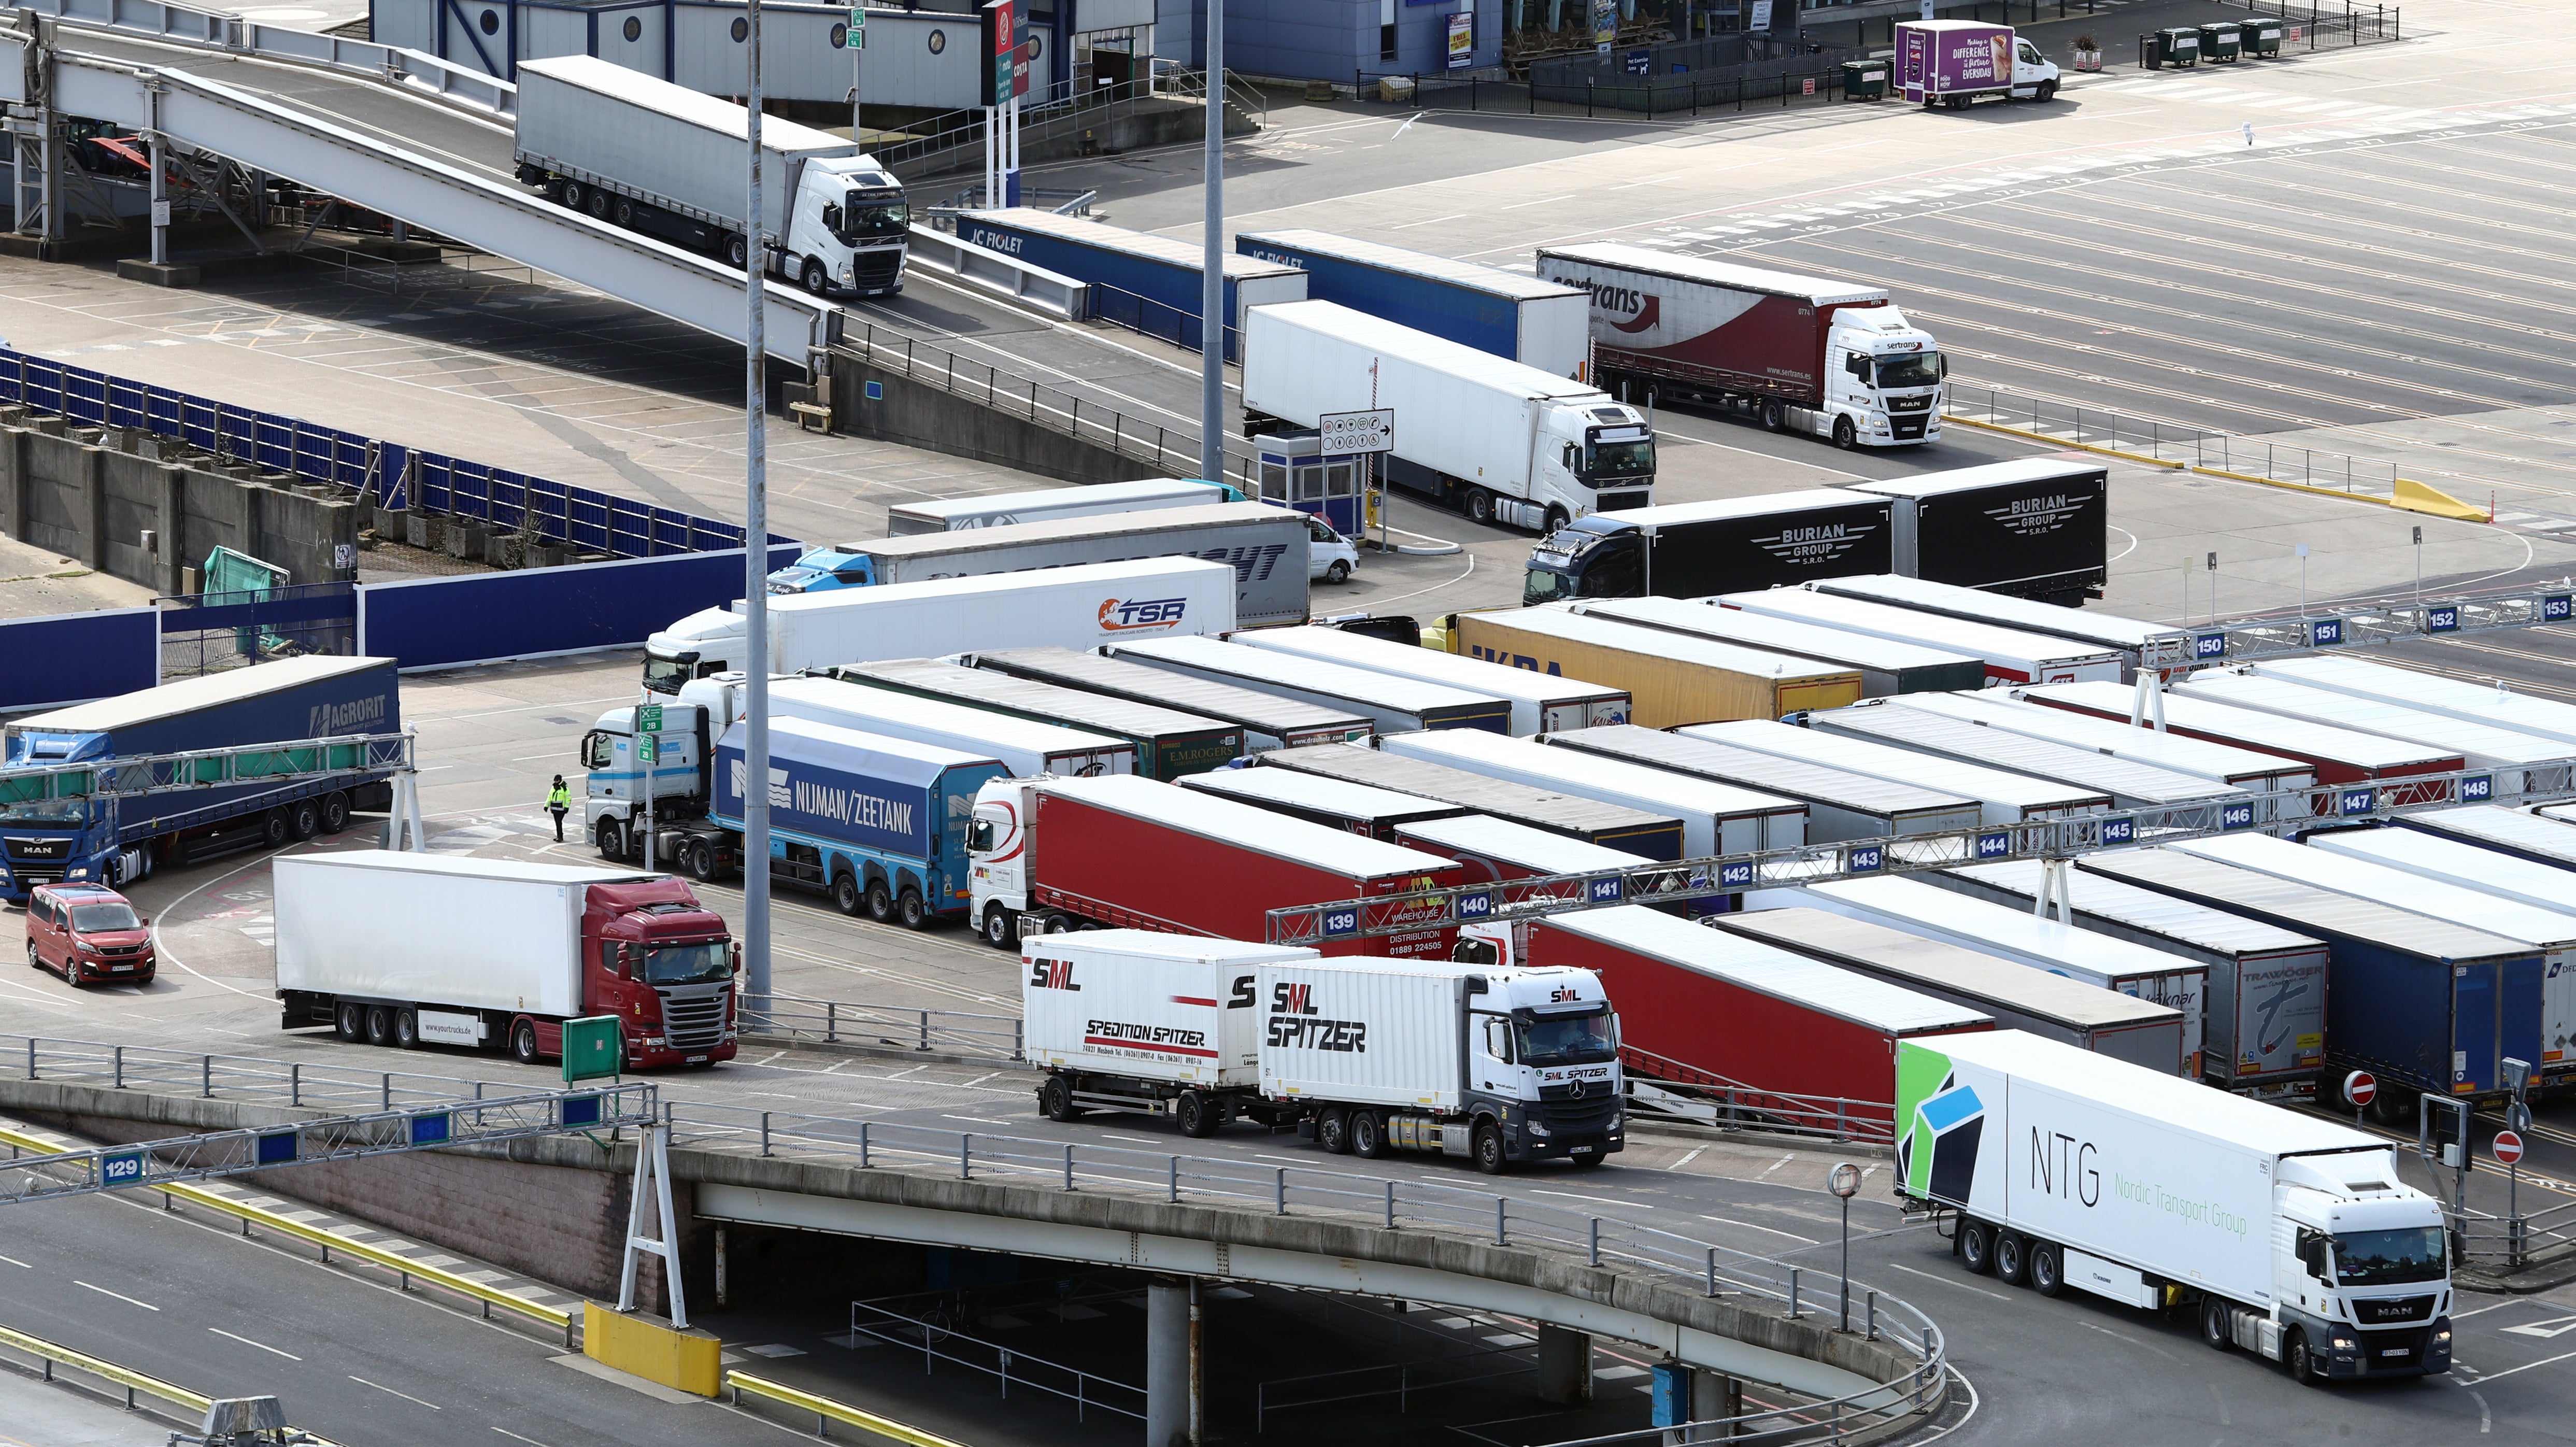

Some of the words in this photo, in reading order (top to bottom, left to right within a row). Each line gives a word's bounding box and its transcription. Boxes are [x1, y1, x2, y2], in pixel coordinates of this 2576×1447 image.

[1013, 13, 1028, 29] WHSmith
[1453, 32, 1467, 41] FREE
[1014, 61, 1028, 77] COSTA
[1962, 67, 1991, 79] EVERYDAY
[2345, 138, 2385, 147] 177
[2267, 147, 2313, 155] 176
[2115, 164, 2161, 173] 174
[1985, 189, 2032, 197] 172
[1854, 211, 1903, 220] 170
[970, 228, 985, 245] JC
[986, 232, 1023, 253] FIOLET
[1798, 307, 1810, 316] 0774
[1767, 366, 1811, 380] www.sertrans.es
[2011, 493, 2067, 515] BURIAN
[2020, 514, 2057, 528] GROUP
[1782, 523, 1845, 544] BURIAN
[2028, 527, 2048, 536] S.R.O.
[1793, 543, 1834, 557] GROUP
[1802, 556, 1825, 565] S.R.O.
[1117, 601, 1187, 625] TSR
[2544, 600, 2568, 616] 153
[2430, 612, 2454, 627] 152
[2315, 625, 2337, 641] 151
[2198, 639, 2222, 653] 150
[331, 694, 386, 728] AGRORIT
[343, 723, 364, 733] TRANSPORT
[364, 718, 385, 728] SOLUTIONS
[1292, 736, 1330, 746] www.drauholz
[1170, 746, 1234, 762] E.M.ROGERS
[2463, 780, 2488, 797] 148
[795, 780, 913, 836] NIJMAN/ZEETANK
[2344, 794, 2369, 810] 147
[2224, 809, 2250, 826] 146
[948, 820, 972, 832] NIJMA
[2104, 822, 2130, 839] 145
[1979, 836, 2006, 854] 144
[1852, 850, 1878, 867] 143
[1723, 866, 1750, 884] 142
[1594, 881, 1618, 897] 141
[1460, 896, 1488, 913] 140
[1327, 913, 1354, 930] 139
[1391, 909, 1439, 922] WAREHOUSE
[1390, 930, 1440, 944] DISTRIBUTION
[1390, 945, 1413, 955] 01889
[1415, 941, 1442, 952] 224505
[1031, 958, 1081, 991] SML
[1271, 982, 1318, 1015] SML
[1550, 989, 1582, 1003] SML
[425, 1023, 471, 1036] www.yourtrucks.de
[1086, 1019, 1151, 1041] SPEDITION
[1152, 1027, 1205, 1046] SPITZER
[1266, 1016, 1366, 1053] SPITZER
[1082, 1045, 1095, 1053] 74821
[1097, 1046, 1114, 1055] Mosbach
[1123, 1049, 1140, 1058] (06261)
[1140, 1051, 1155, 1059] 8907-0
[1165, 1054, 1183, 1063] (06261)
[1186, 1056, 1202, 1065] 8907-16
[1544, 1071, 1564, 1081] SML
[1567, 1068, 1608, 1080] SPITZER
[106, 1160, 138, 1179] 129
[2032, 1125, 2099, 1208] NTG
[2259, 1162, 2268, 1172] FRC
[2115, 1172, 2151, 1205] Nordic
[2155, 1184, 2208, 1225] Transport
[2212, 1203, 2247, 1242] Group
[2097, 1275, 2111, 1284] KRONE
[2377, 1306, 2413, 1316] MAN
